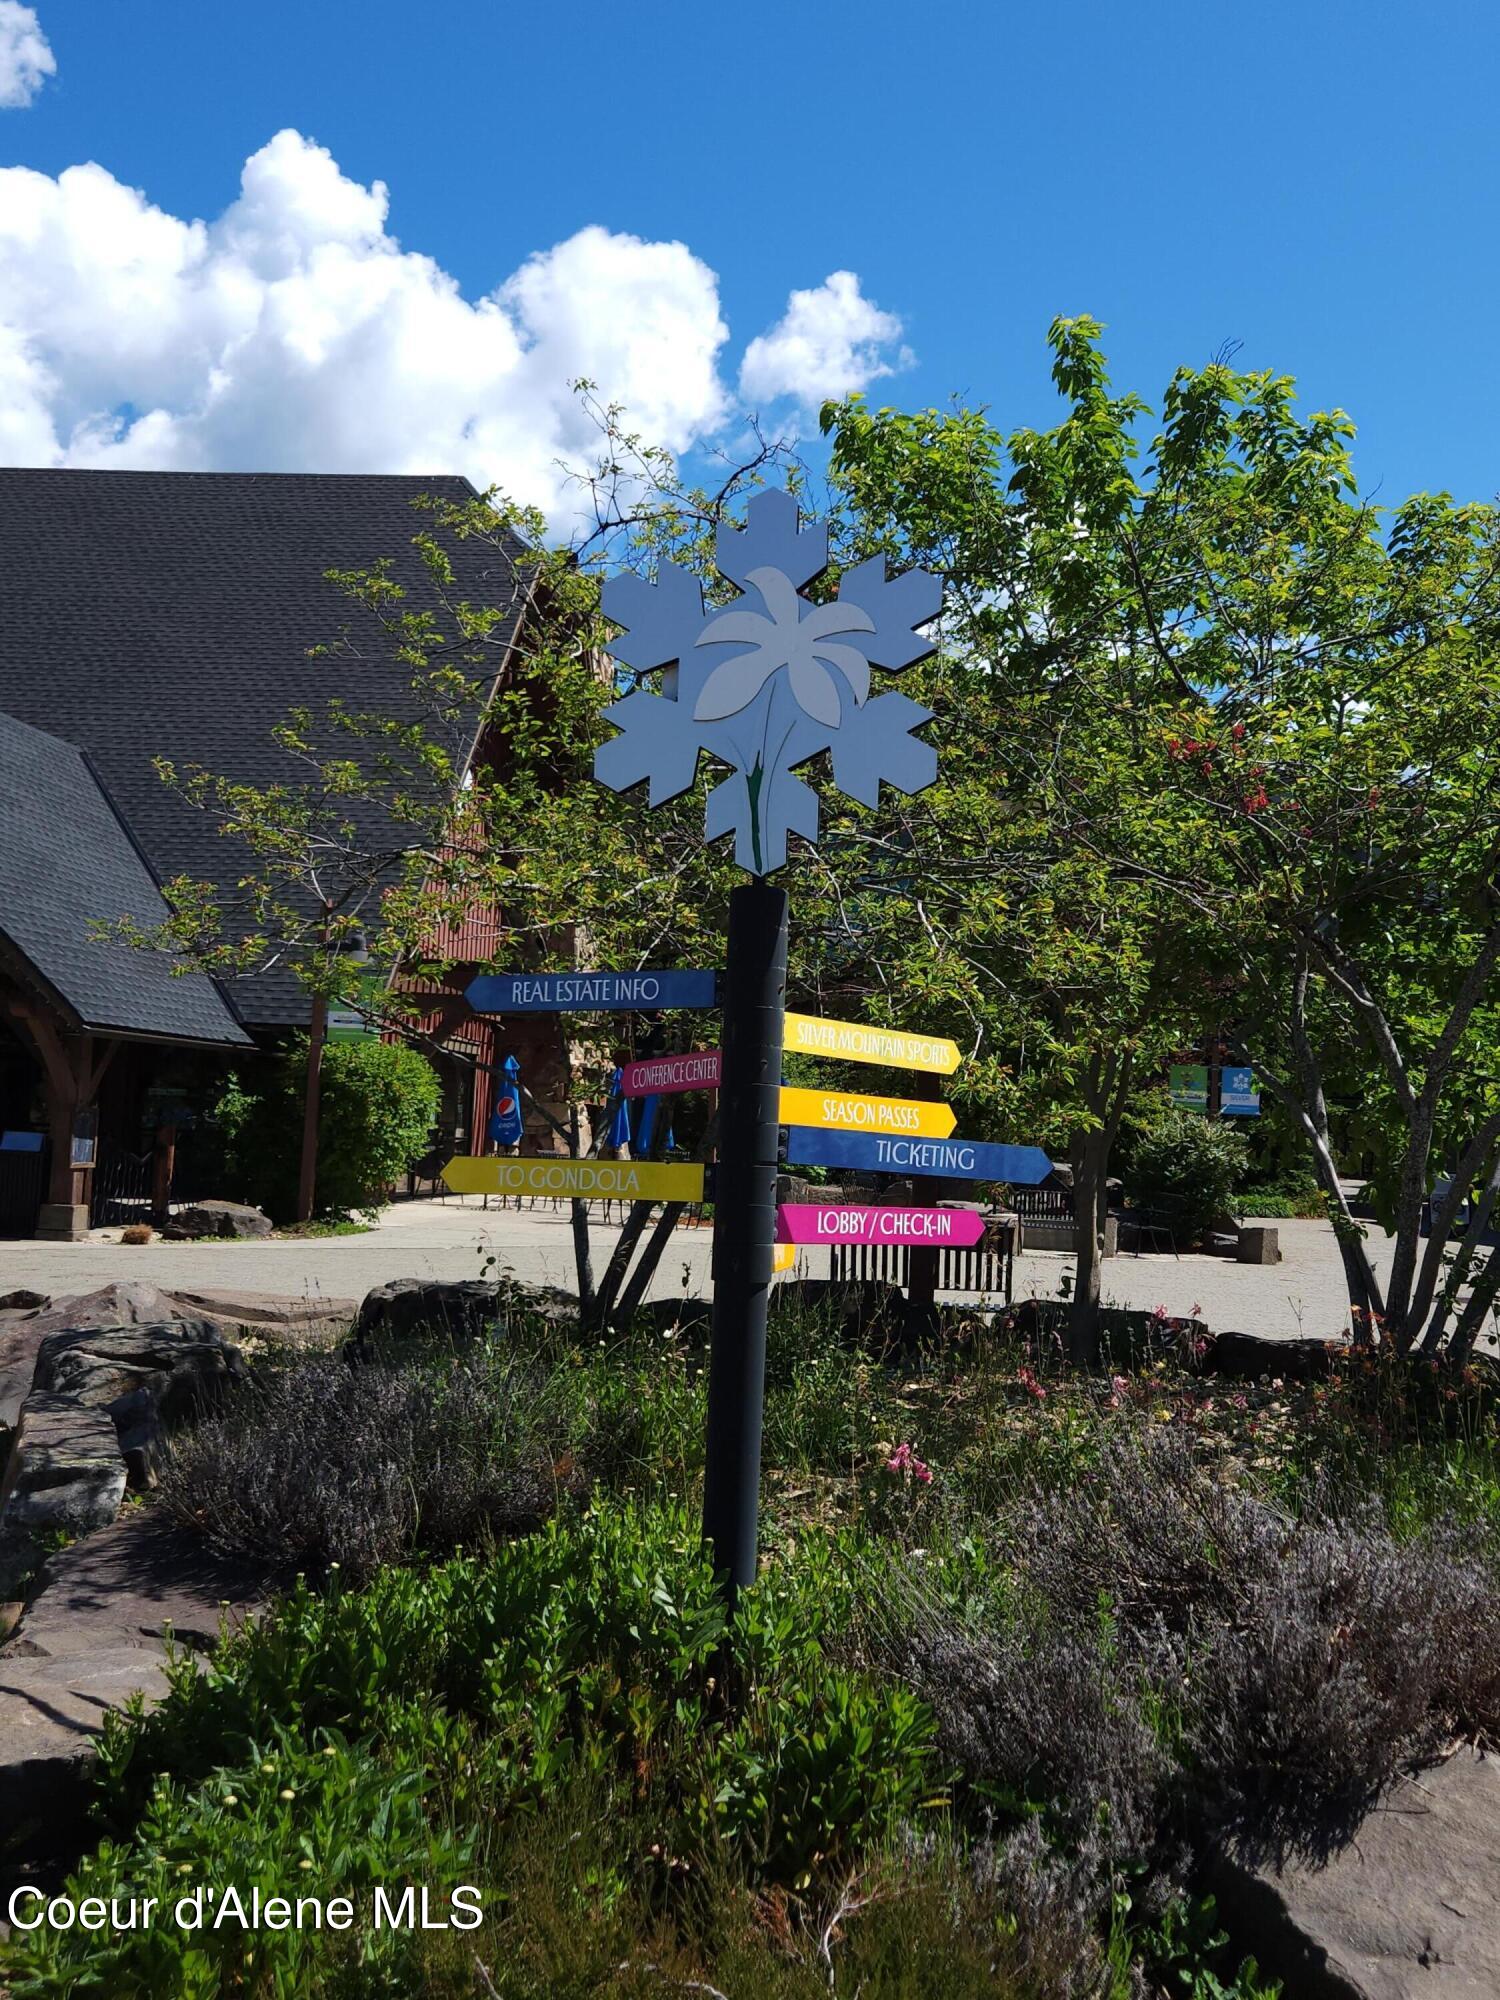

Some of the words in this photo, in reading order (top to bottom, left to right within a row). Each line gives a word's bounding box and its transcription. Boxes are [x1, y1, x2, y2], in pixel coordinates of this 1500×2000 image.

[512, 980, 552, 1004] REAL
[556, 979, 611, 1002] ESTATE
[615, 977, 660, 1000] INFO
[797, 1021, 836, 1050] SILVER
[838, 1031, 905, 1058] MOUNTAIN
[907, 1039, 951, 1066] SPORTS
[632, 1062, 685, 1088] CONFERENCE
[685, 1057, 718, 1081] CENTER
[822, 1098, 876, 1125] SEASON
[878, 1104, 920, 1130] PASSES
[876, 1140, 975, 1170] TICKETING
[496, 1165, 525, 1188] TO
[528, 1166, 640, 1192] GONDOLA
[817, 1211, 868, 1235] LOBBY
[880, 1212, 951, 1238] CHECK-IN
